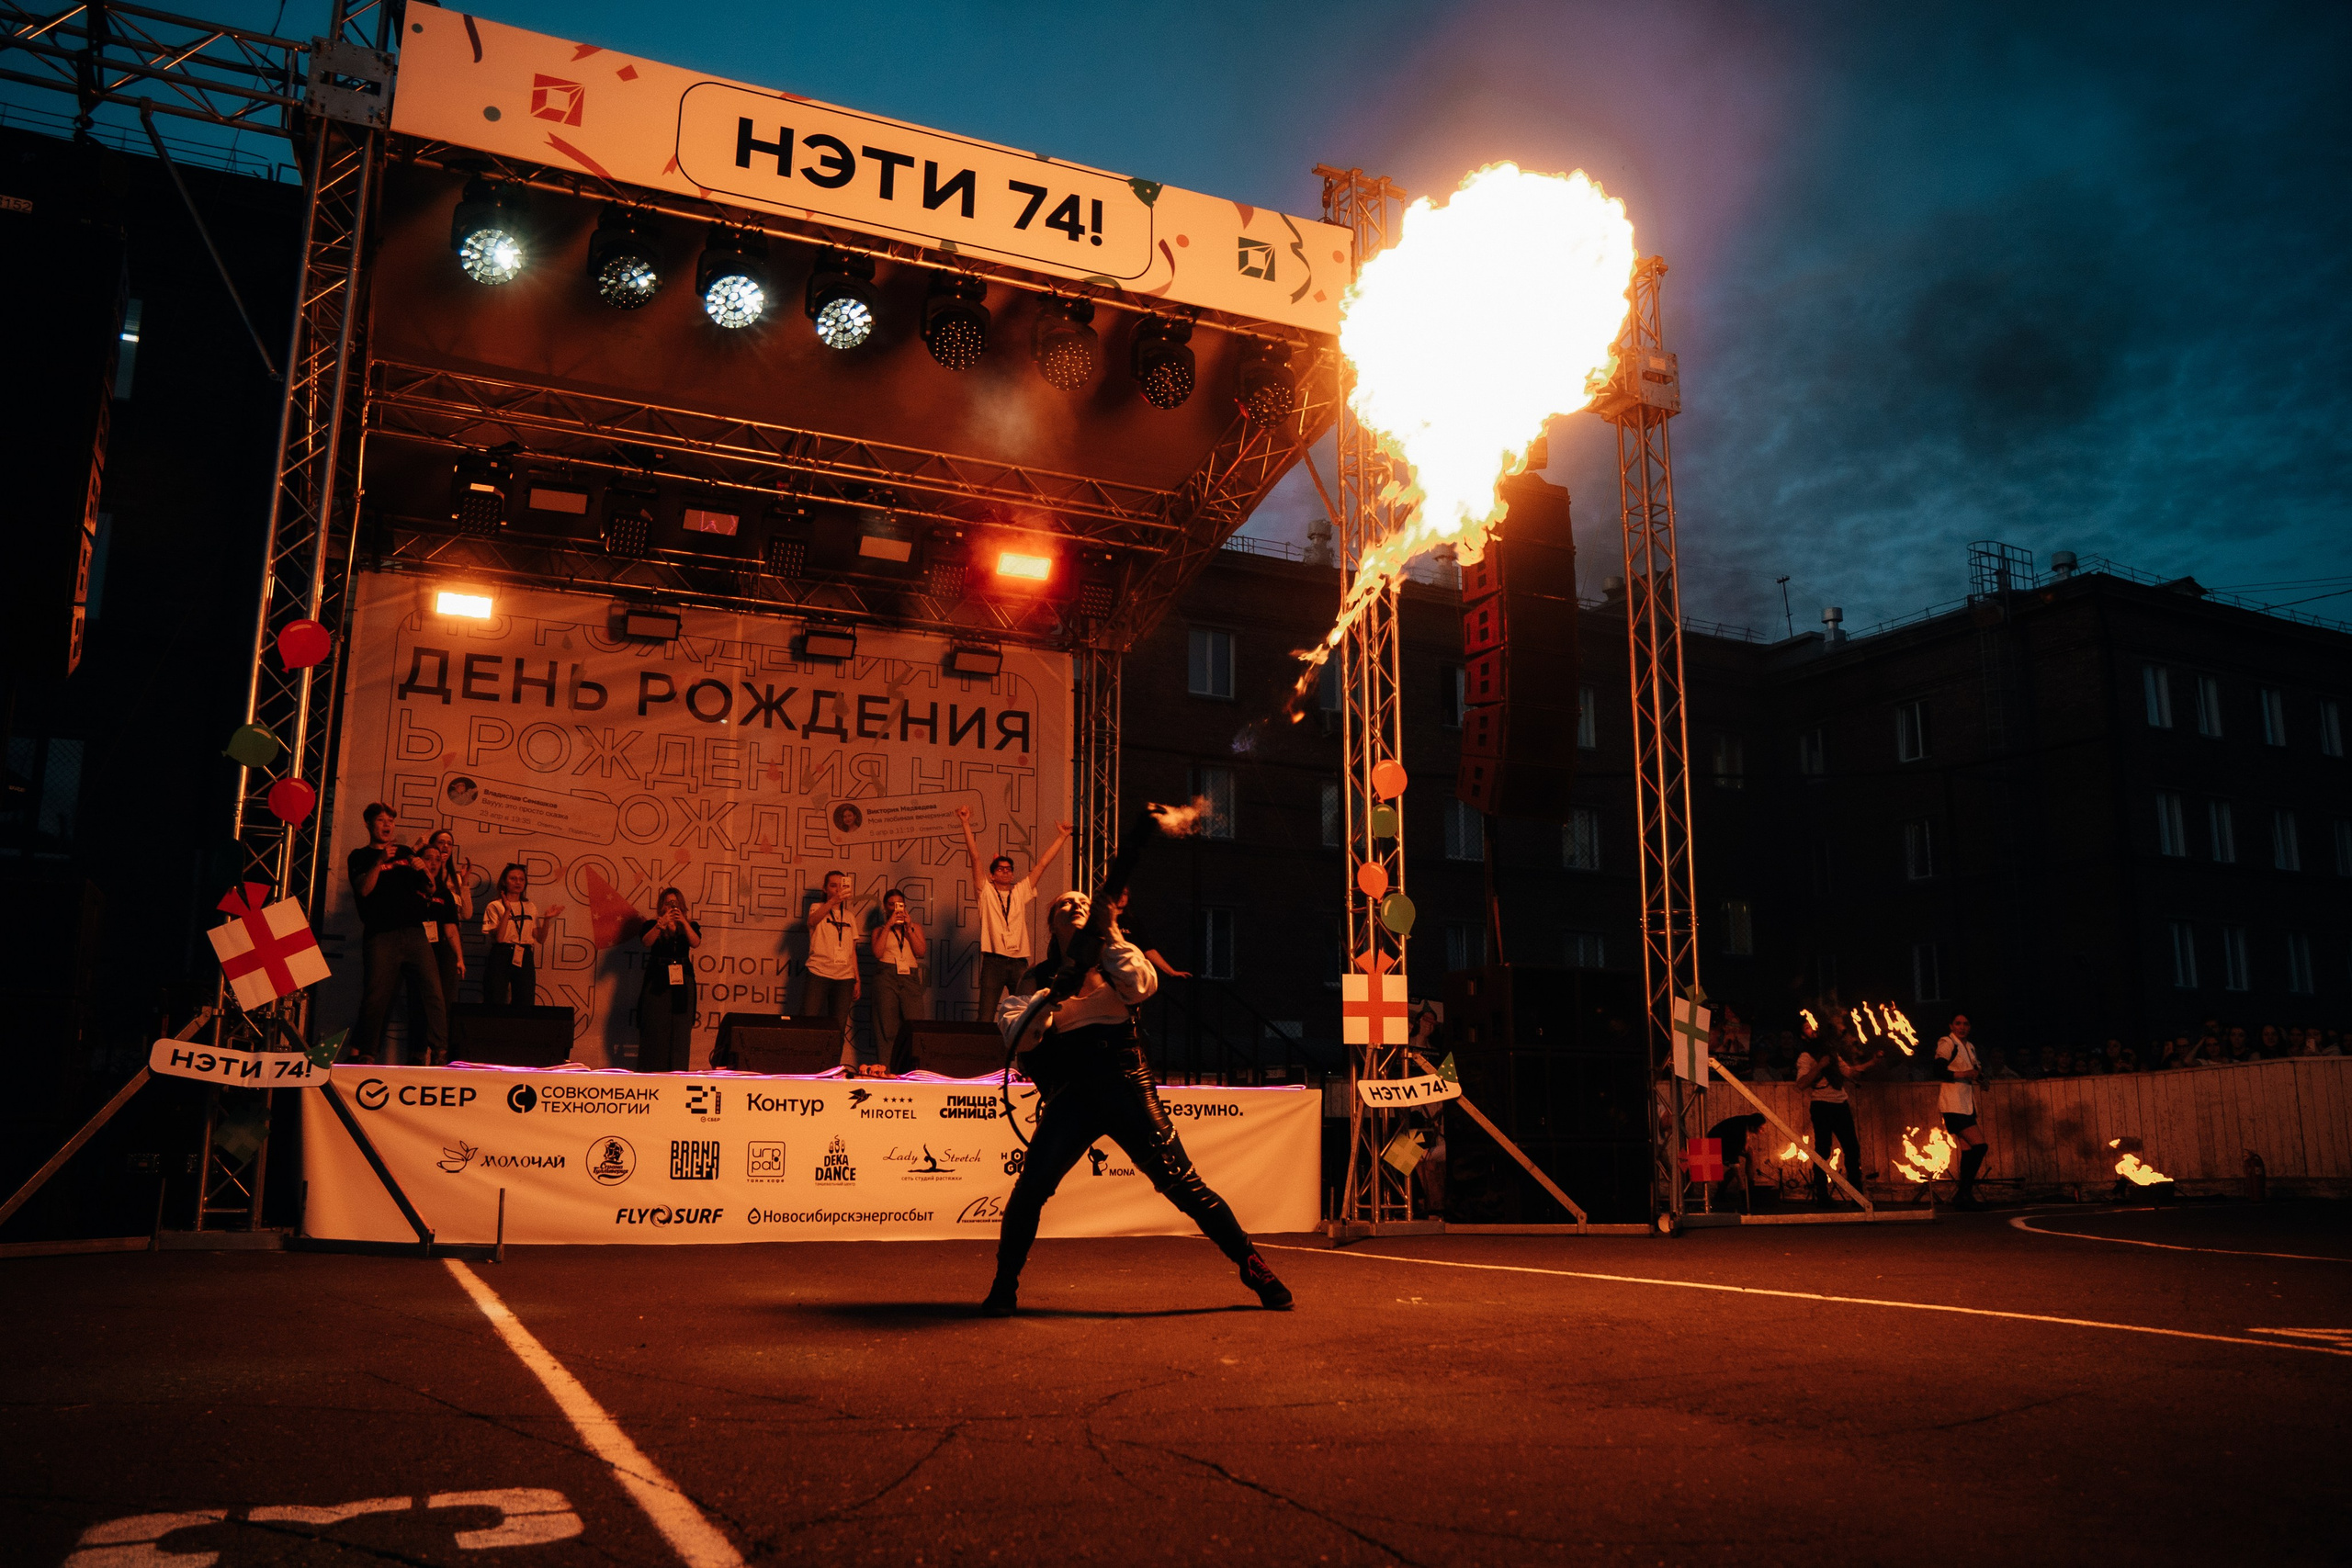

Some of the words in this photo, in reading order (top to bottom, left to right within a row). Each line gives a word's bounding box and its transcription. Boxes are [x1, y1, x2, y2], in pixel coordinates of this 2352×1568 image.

[735, 116, 976, 220] НЭТИ
[1007, 178, 1103, 247] 74!
[398, 647, 608, 711] ДЕНЬ
[638, 671, 1030, 753] РОЖДЕНИЯ
[466, 715, 888, 798] РОЖДЕНИЯ
[170, 1049, 262, 1078] НЭТИ
[274, 1060, 313, 1079] 74!
[399, 1086, 477, 1106] СБЕР
[541, 1086, 661, 1101] СОВКОМБАНК
[1368, 1086, 1419, 1100] НЭТИ
[1421, 1078, 1449, 1096] 74!
[541, 1101, 650, 1114] ТЕХНОЛОГИИ
[746, 1093, 825, 1117] Контур
[946, 1095, 997, 1108] пицца
[1159, 1100, 1244, 1121] Безумно.
[860, 1109, 917, 1120] MIROTEL
[939, 1108, 997, 1121] синица
[823, 1154, 849, 1168] DEKA
[882, 1146, 919, 1165] Lady
[939, 1148, 981, 1163] Stretch
[815, 1166, 856, 1181] DANCE
[1108, 1168, 1136, 1177] MONA
[763, 1207, 934, 1225] Новосибирскэнергосбыт
